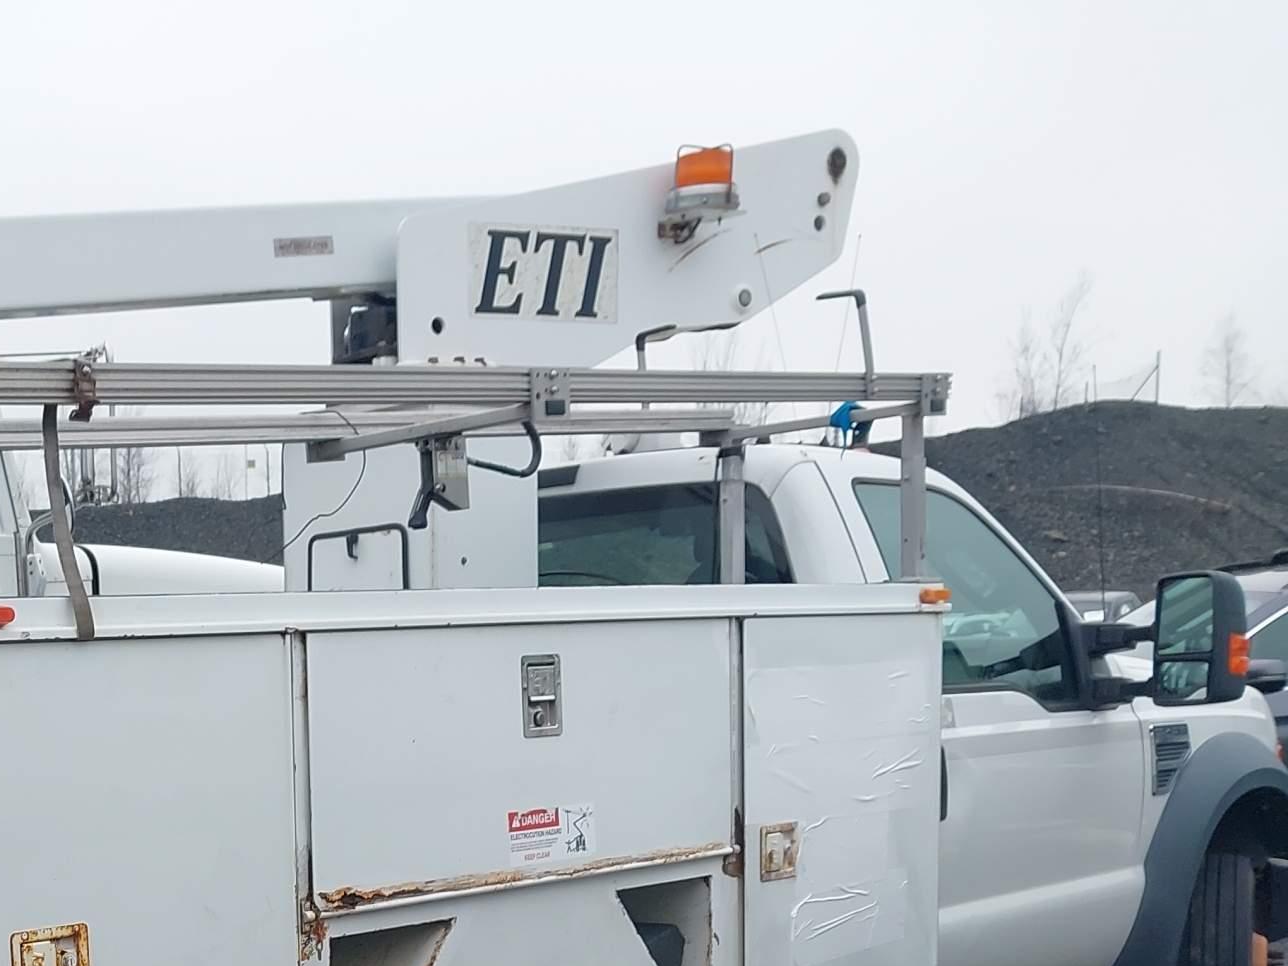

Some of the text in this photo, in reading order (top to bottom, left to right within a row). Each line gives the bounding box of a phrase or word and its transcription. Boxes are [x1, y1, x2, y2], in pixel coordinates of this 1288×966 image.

[474, 229, 613, 318] ETI
[521, 811, 556, 827] DANGER
[510, 830, 545, 841] ELECTROCUTION
